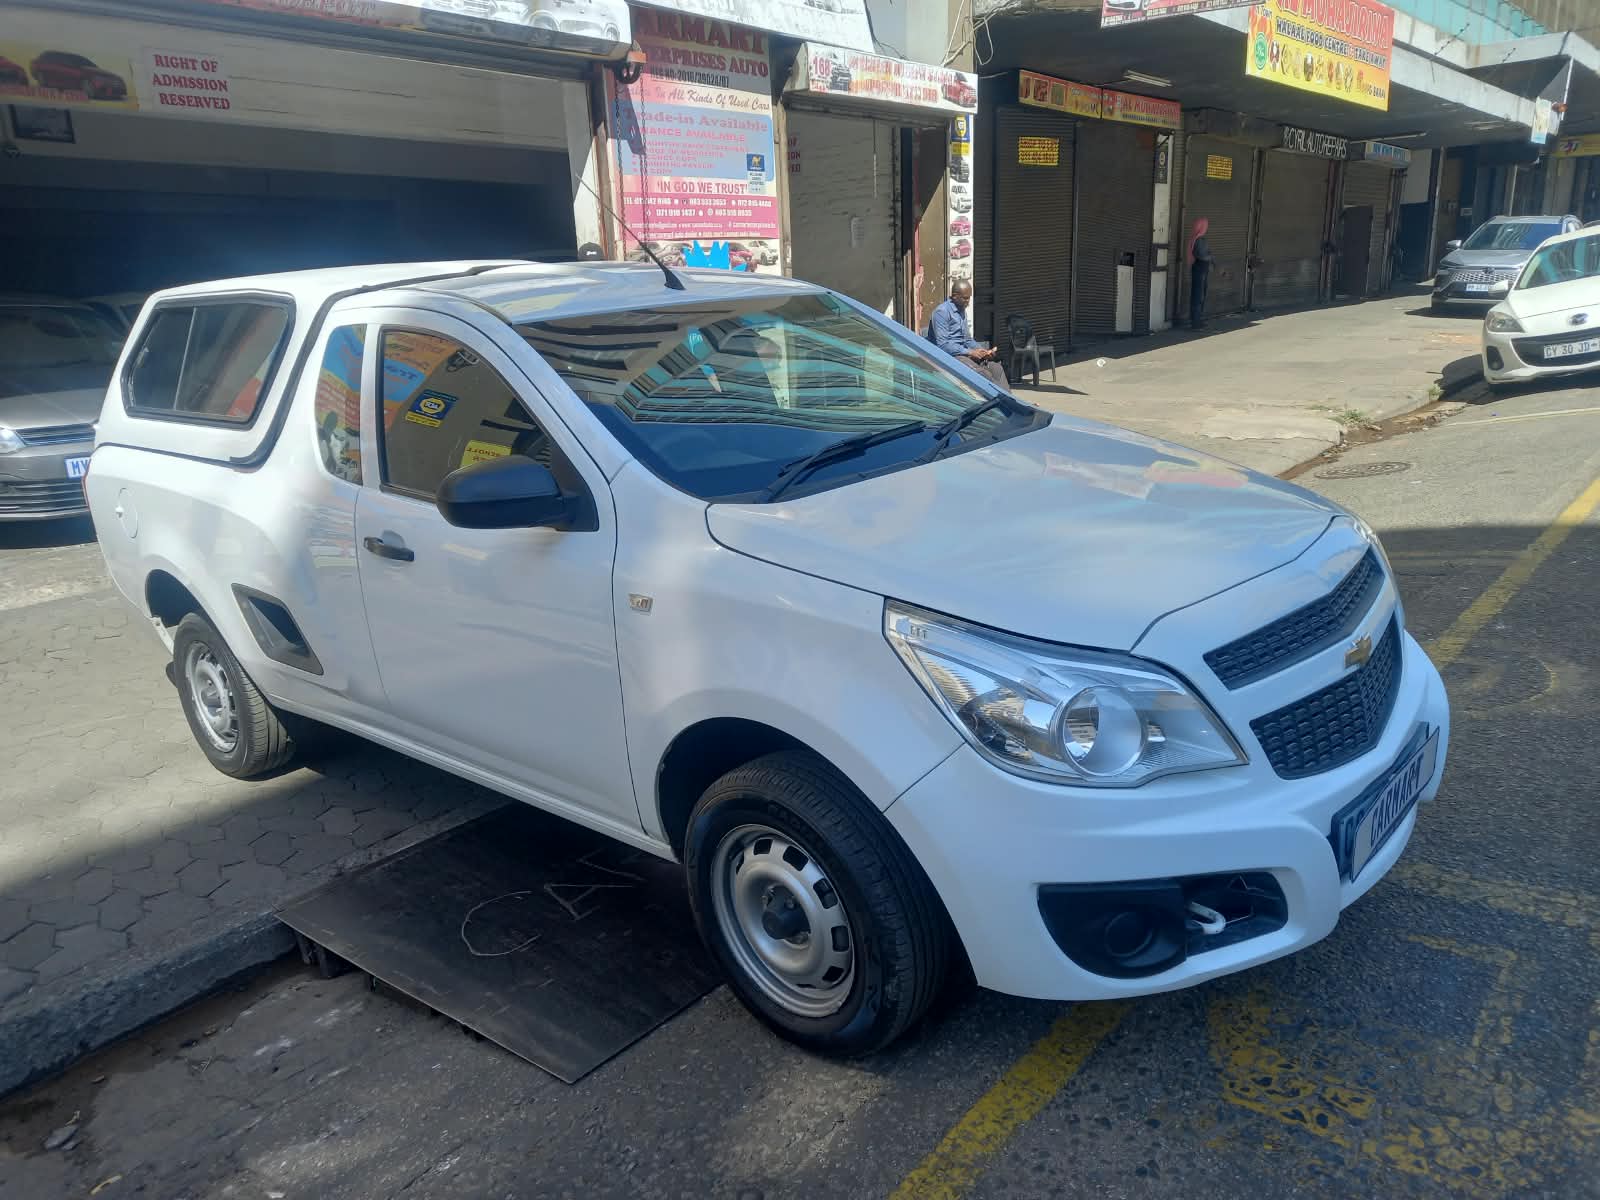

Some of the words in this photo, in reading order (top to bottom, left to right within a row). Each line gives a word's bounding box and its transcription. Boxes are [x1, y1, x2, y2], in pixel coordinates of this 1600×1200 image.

[1306, 28, 1323, 49] FOOD
[1324, 35, 1348, 56] CENTRE
[154, 54, 198, 72] RIGHT
[201, 58, 218, 73] OF
[729, 55, 769, 78] AUTO
[812, 56, 831, 77] 168
[152, 73, 228, 92] ADMISSION
[159, 92, 230, 110] RESERVED
[751, 98, 770, 111] Cars
[700, 115, 769, 132] Available
[674, 182, 695, 193] GOD
[697, 182, 713, 193] WE
[1562, 344, 1574, 355] 30
[1371, 754, 1424, 847] CARMART
